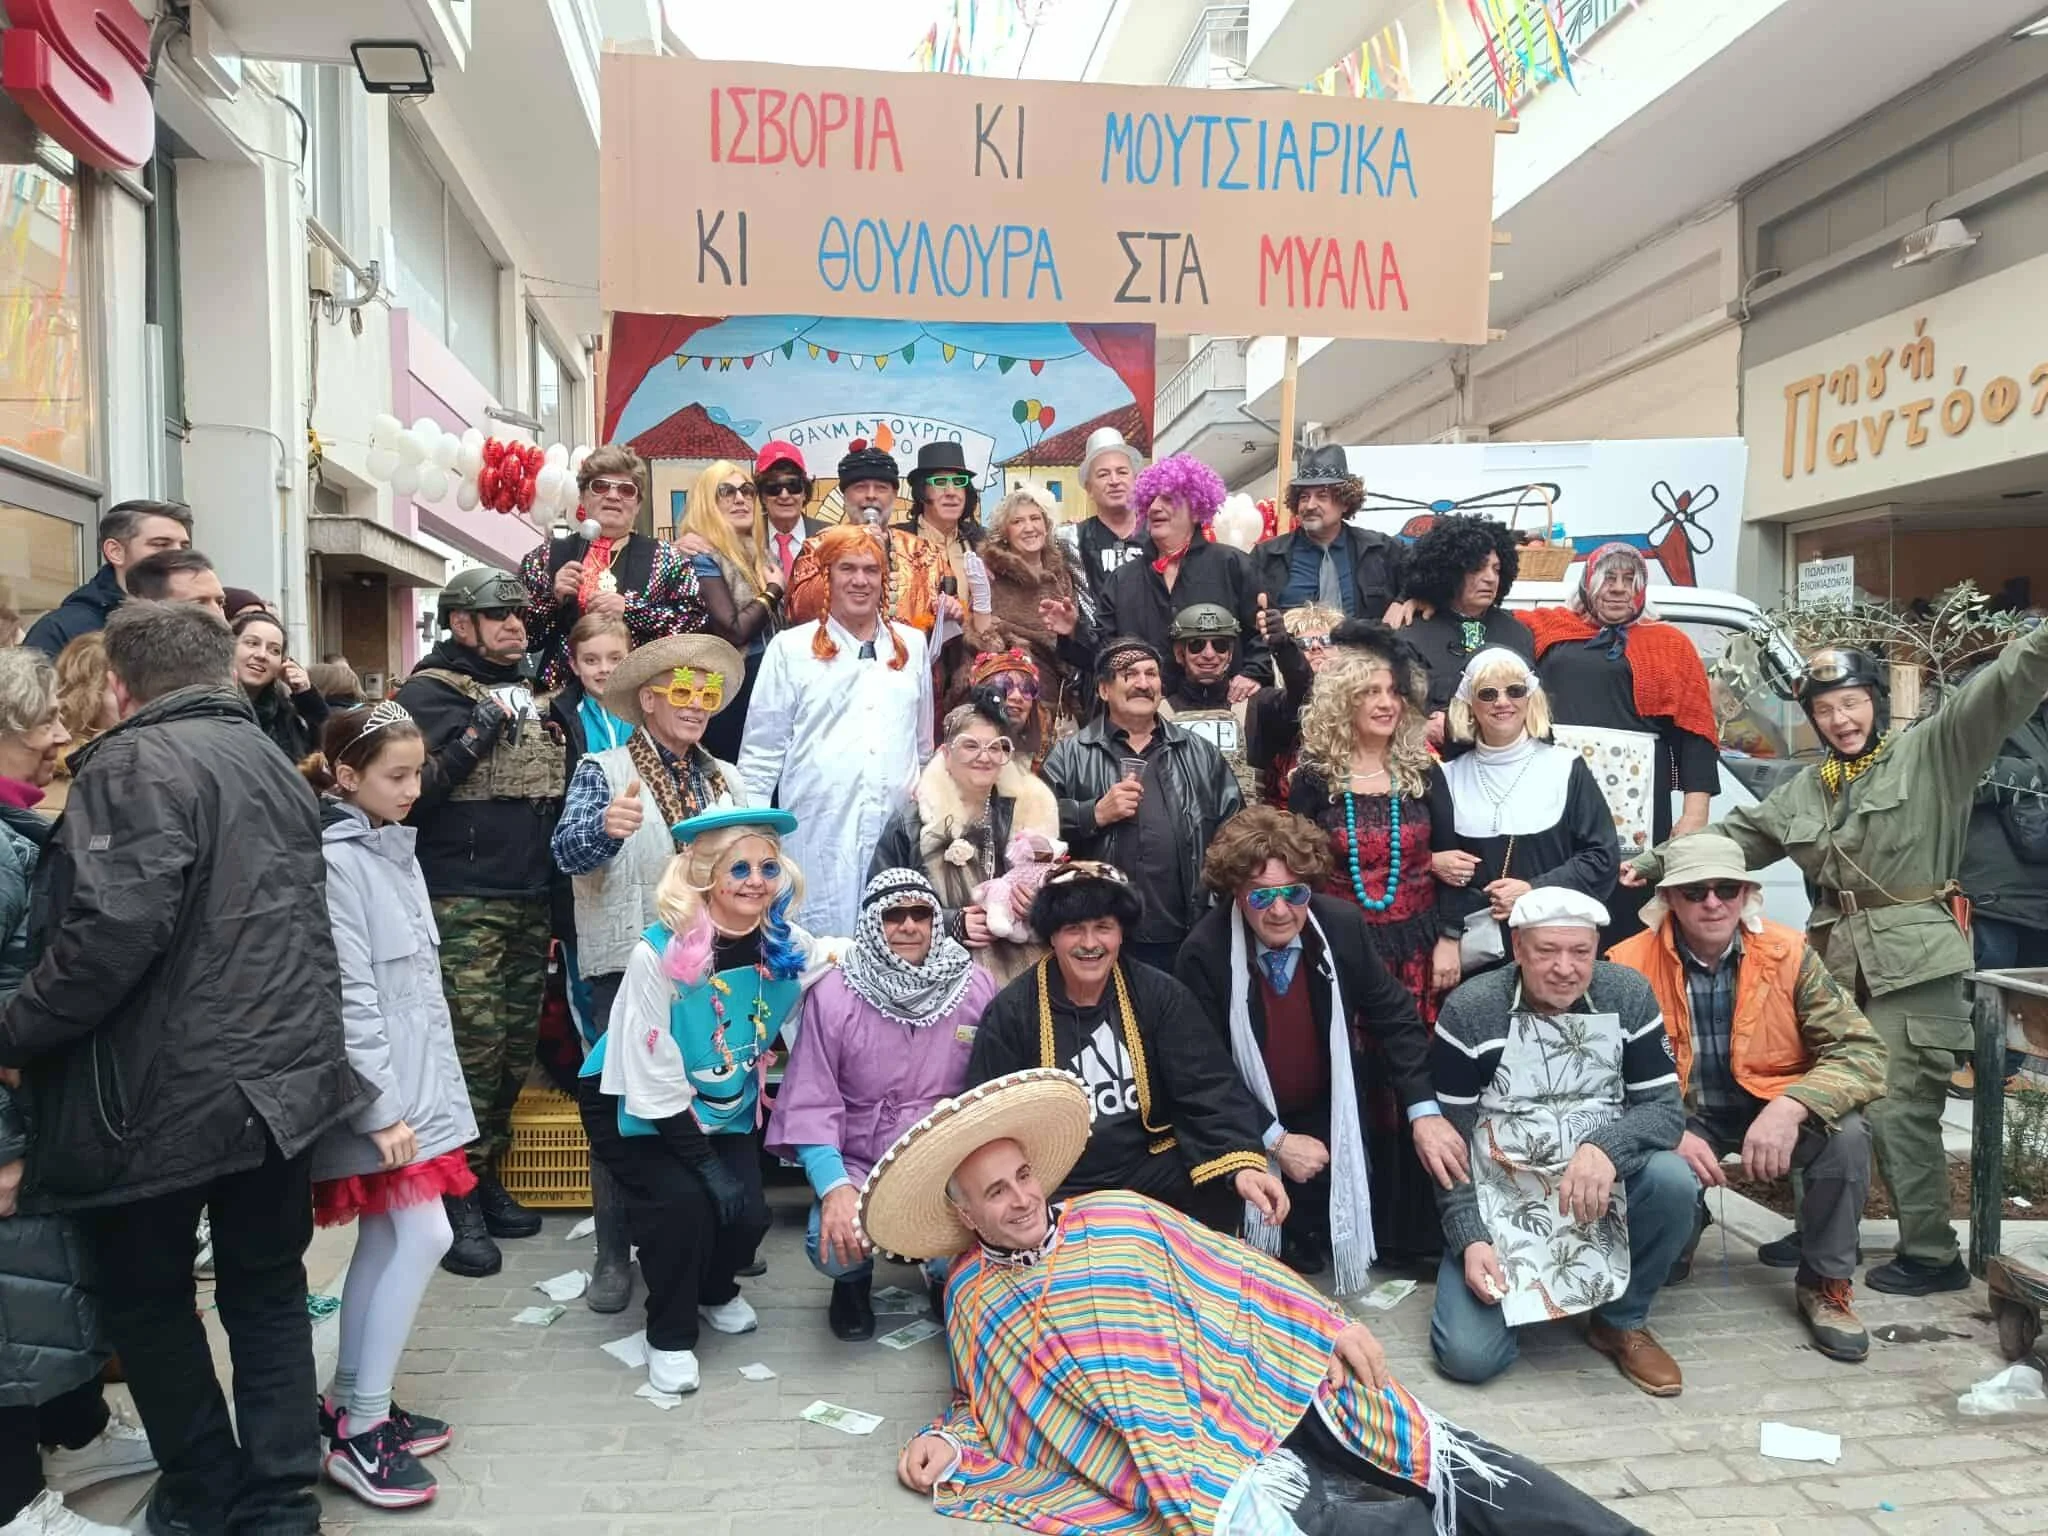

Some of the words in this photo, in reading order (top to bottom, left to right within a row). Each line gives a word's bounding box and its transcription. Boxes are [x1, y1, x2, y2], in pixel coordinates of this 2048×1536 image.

[710, 87, 904, 172] ΙΣΒΟΡΙΑ
[974, 103, 1025, 180] ΚΙ
[1100, 111, 1418, 199] ΜΟΥΤΣΙΑΡΙΚΑ
[696, 208, 747, 286] ΚΙ
[818, 216, 1063, 301] ΘΟΥΛΟΥΡΑ
[1113, 231, 1209, 305] ΣΤΑ
[1259, 233, 1409, 312] ΜΥΑΛΑ
[1804, 563, 1848, 578] ΠΩΛΟΥΝΤΑΙ
